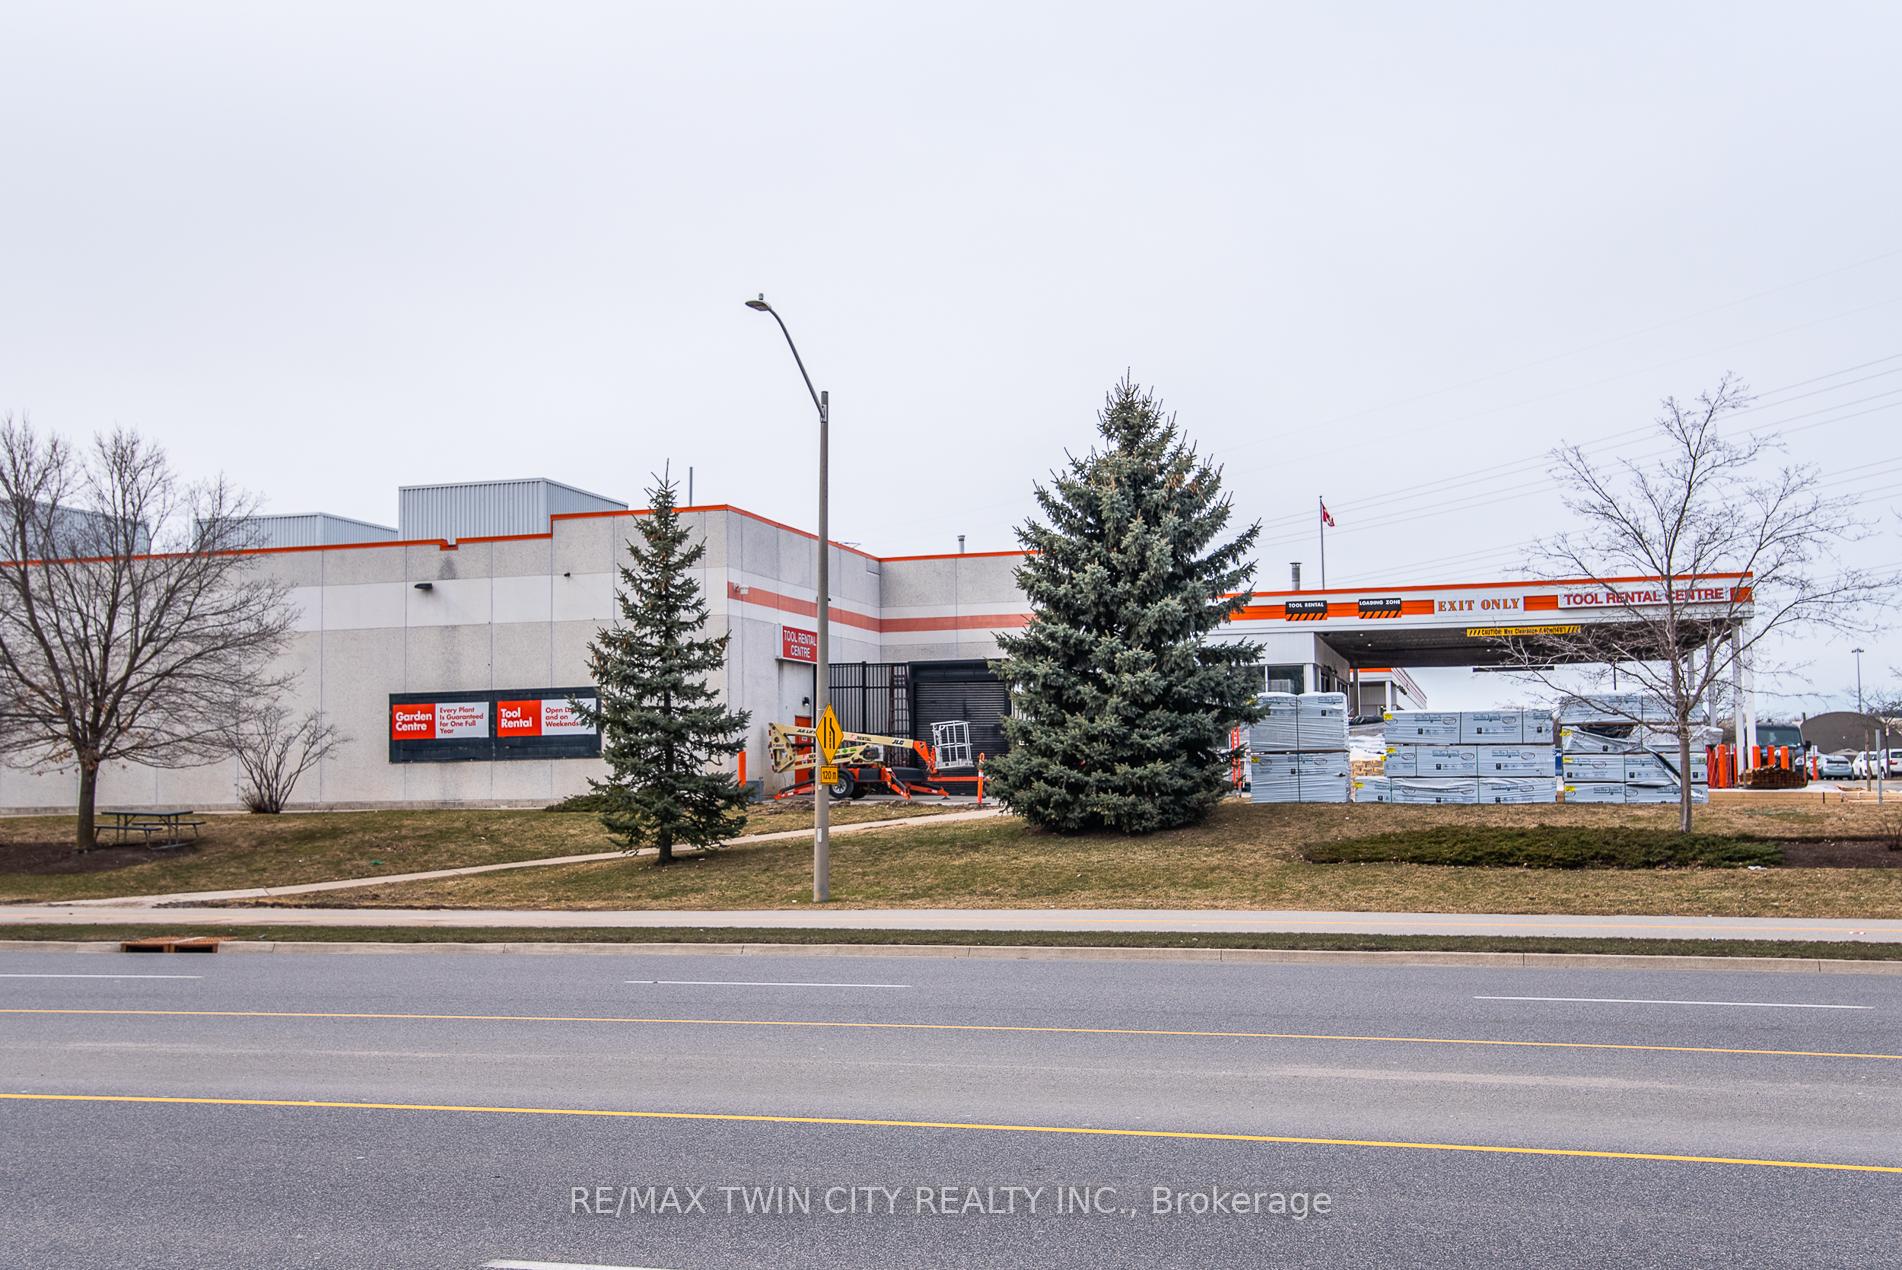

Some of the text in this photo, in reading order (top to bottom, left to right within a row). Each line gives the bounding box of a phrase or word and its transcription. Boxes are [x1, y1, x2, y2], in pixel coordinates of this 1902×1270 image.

[1564, 593, 1603, 606] TOOL
[1606, 590, 1660, 604] RENTAL
[1438, 598, 1520, 612] EXIT ONLY
[784, 630, 817, 646] TOOL RENTAL
[791, 645, 811, 658] CENTRE
[395, 710, 433, 722] Garden
[501, 707, 521, 718] Tool
[545, 706, 564, 714] Open
[395, 720, 428, 732] Centre
[501, 716, 533, 729] Rental
[545, 720, 579, 728] Weekends
[822, 770, 833, 780] 120
